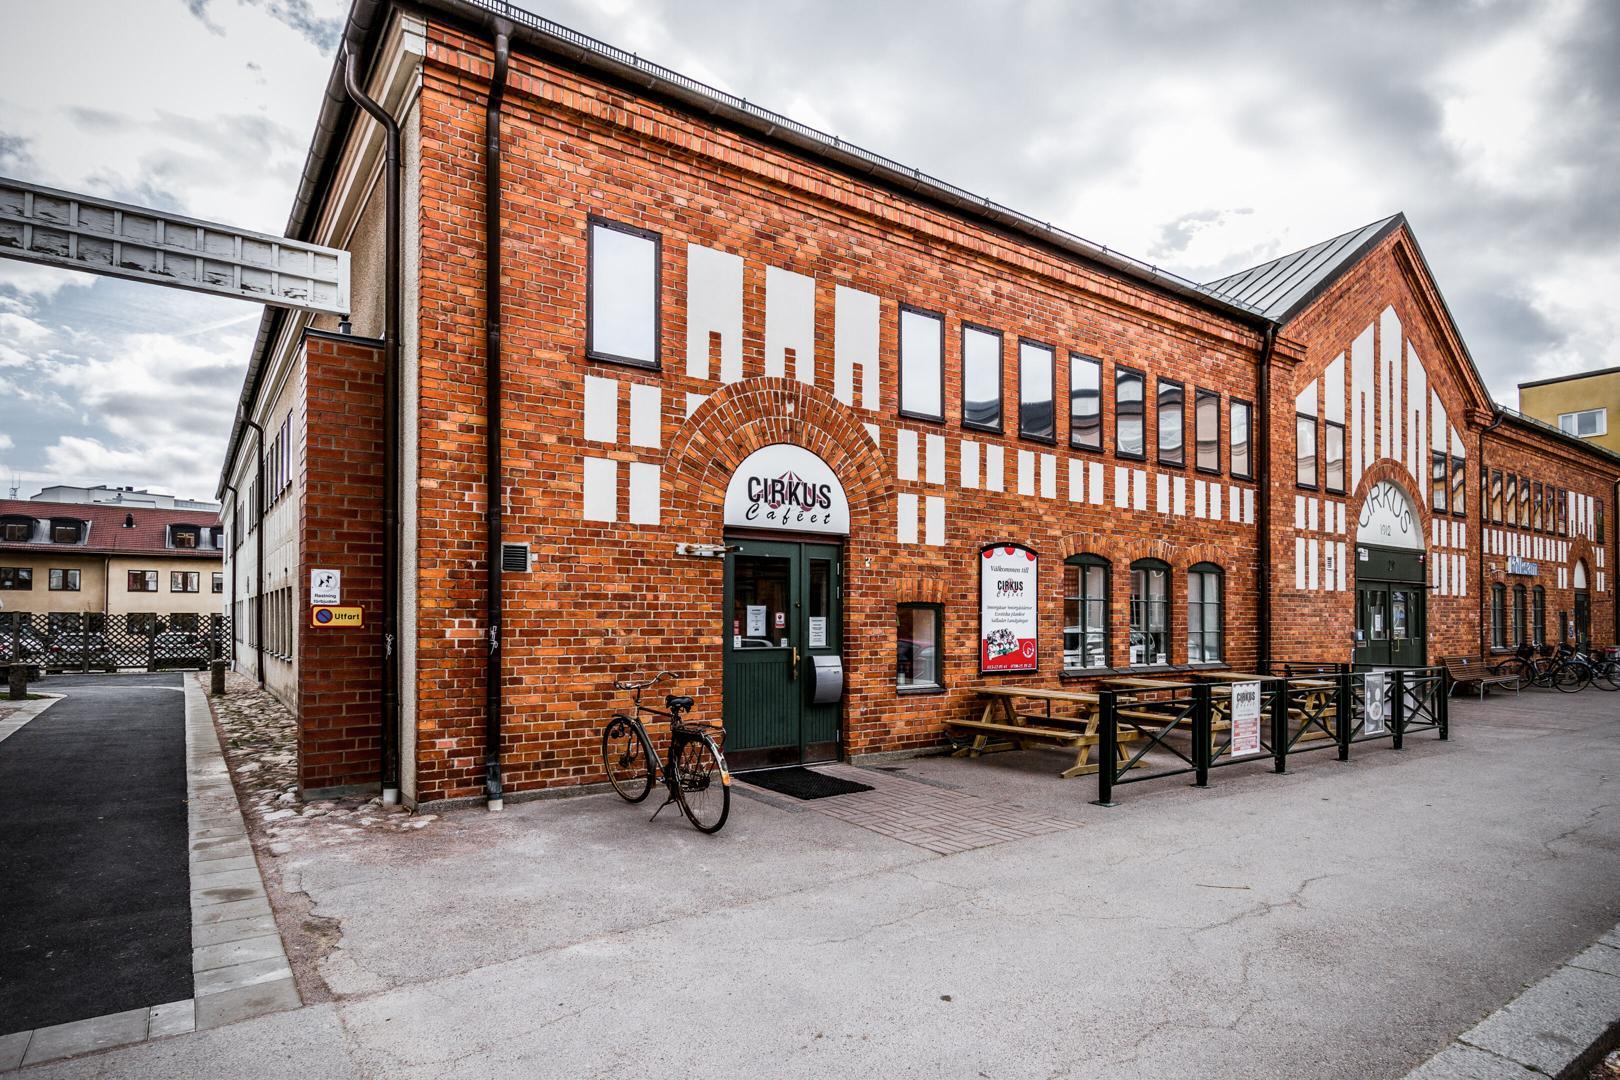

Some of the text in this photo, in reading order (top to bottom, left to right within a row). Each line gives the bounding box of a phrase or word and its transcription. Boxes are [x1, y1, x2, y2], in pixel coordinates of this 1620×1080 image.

[747, 476, 831, 509] CIRKUS
[997, 580, 1024, 591] CIRKUS
[1236, 691, 1256, 703] CIRKUS
